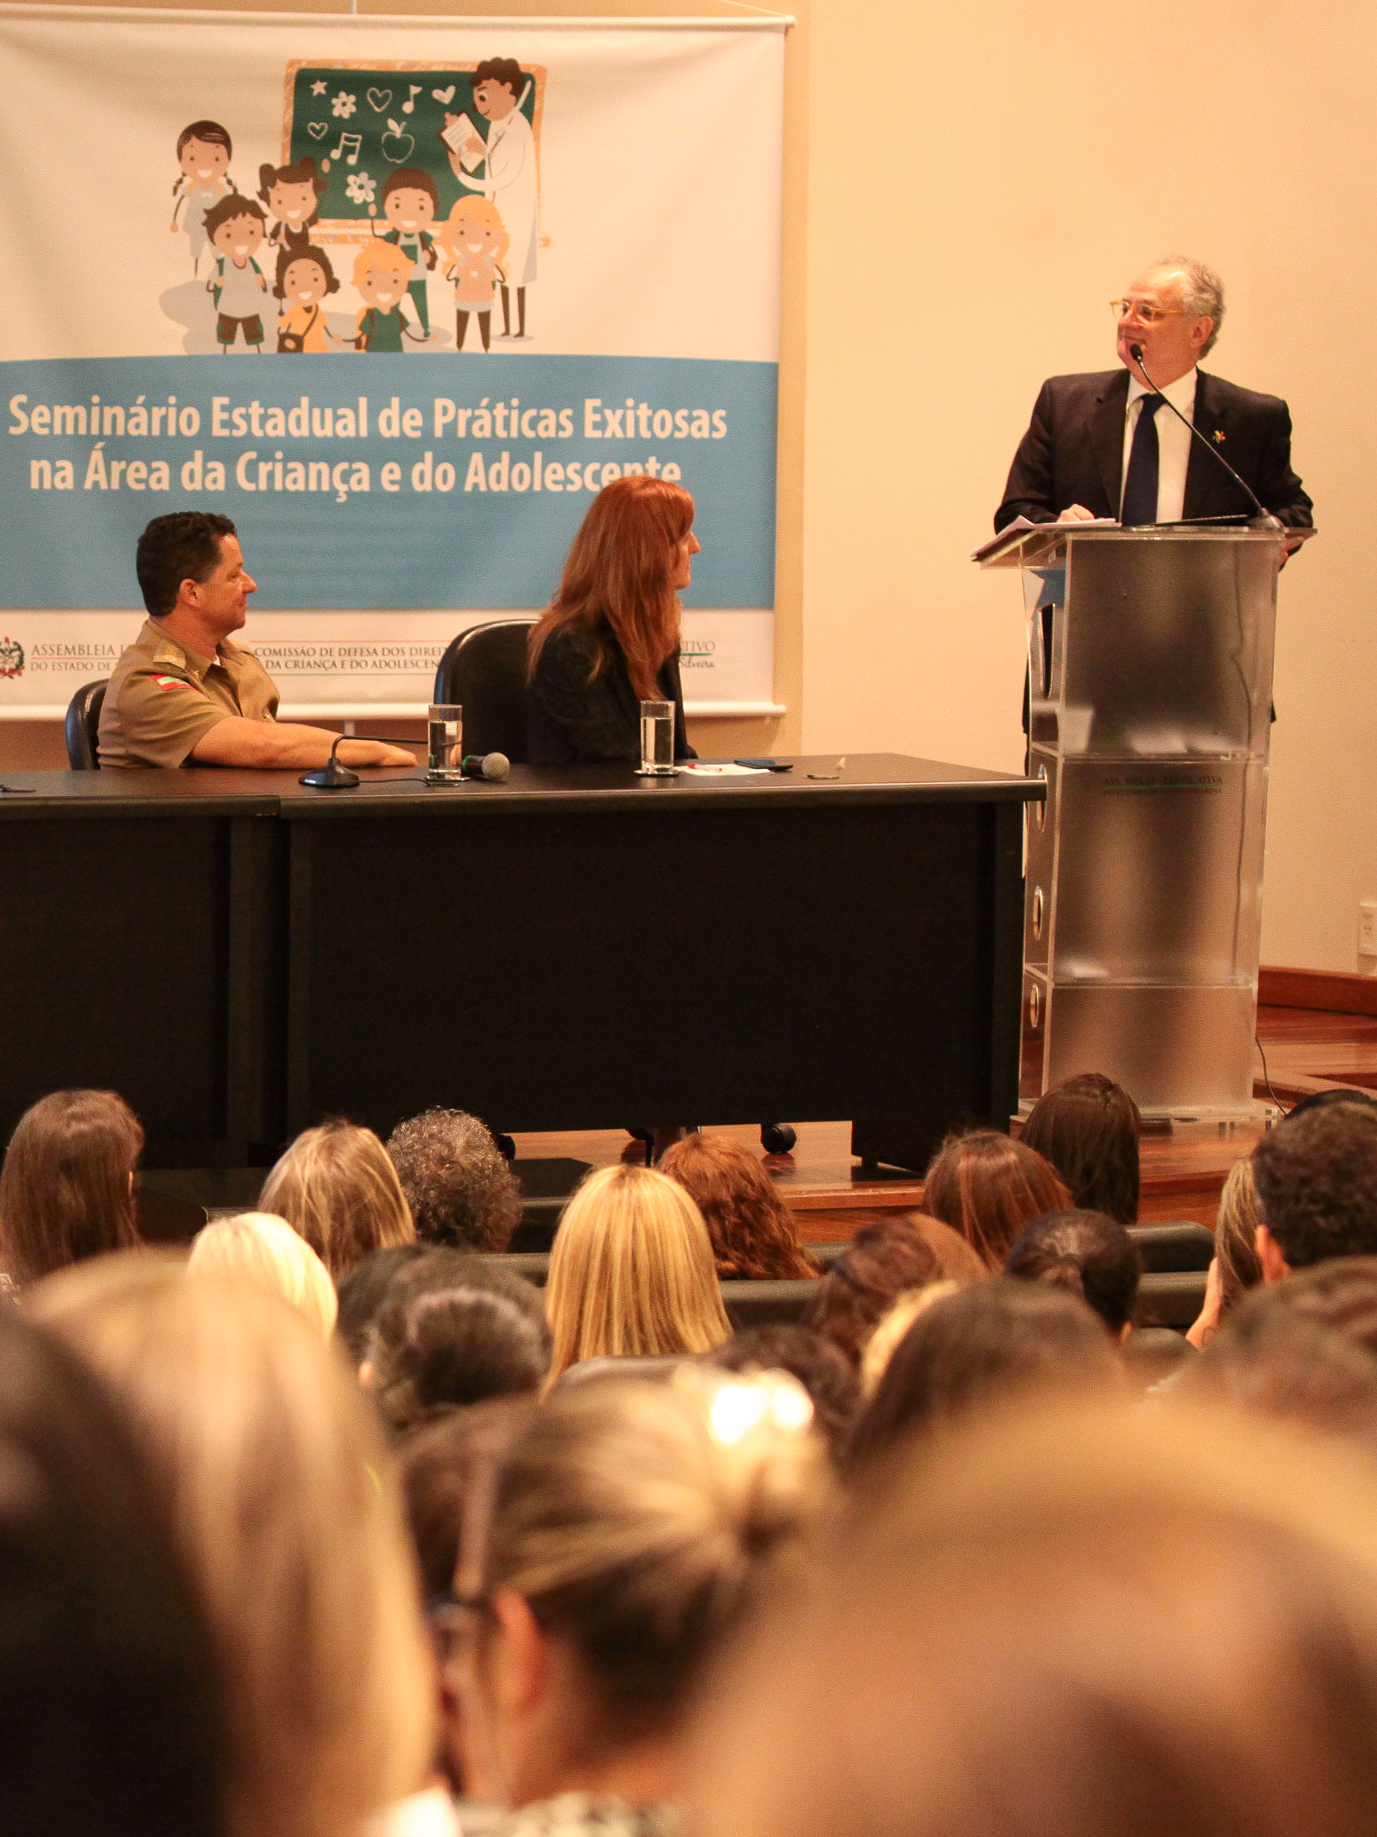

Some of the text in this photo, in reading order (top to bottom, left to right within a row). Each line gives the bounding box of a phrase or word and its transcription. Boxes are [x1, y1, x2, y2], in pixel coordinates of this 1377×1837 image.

[8, 393, 201, 436] Seminário
[211, 396, 368, 437] Estadual
[378, 397, 423, 438] de
[434, 397, 574, 439] Práticas
[584, 398, 728, 440] Exitosas
[29, 441, 682, 502] na Área da Criança e do Adolescente
[31, 643, 116, 656] ASSEMBLEIA
[254, 645, 316, 657] COMISSÃO
[319, 646, 335, 657] DE
[338, 647, 379, 657] DEFESA
[381, 646, 406, 657] DOS
[30, 661, 48, 671] DO
[51, 661, 94, 671] ESTADO
[265, 659, 282, 669] DA
[284, 659, 338, 671] CRIANÇA
[341, 659, 347, 669] E
[349, 659, 369, 669] DO
